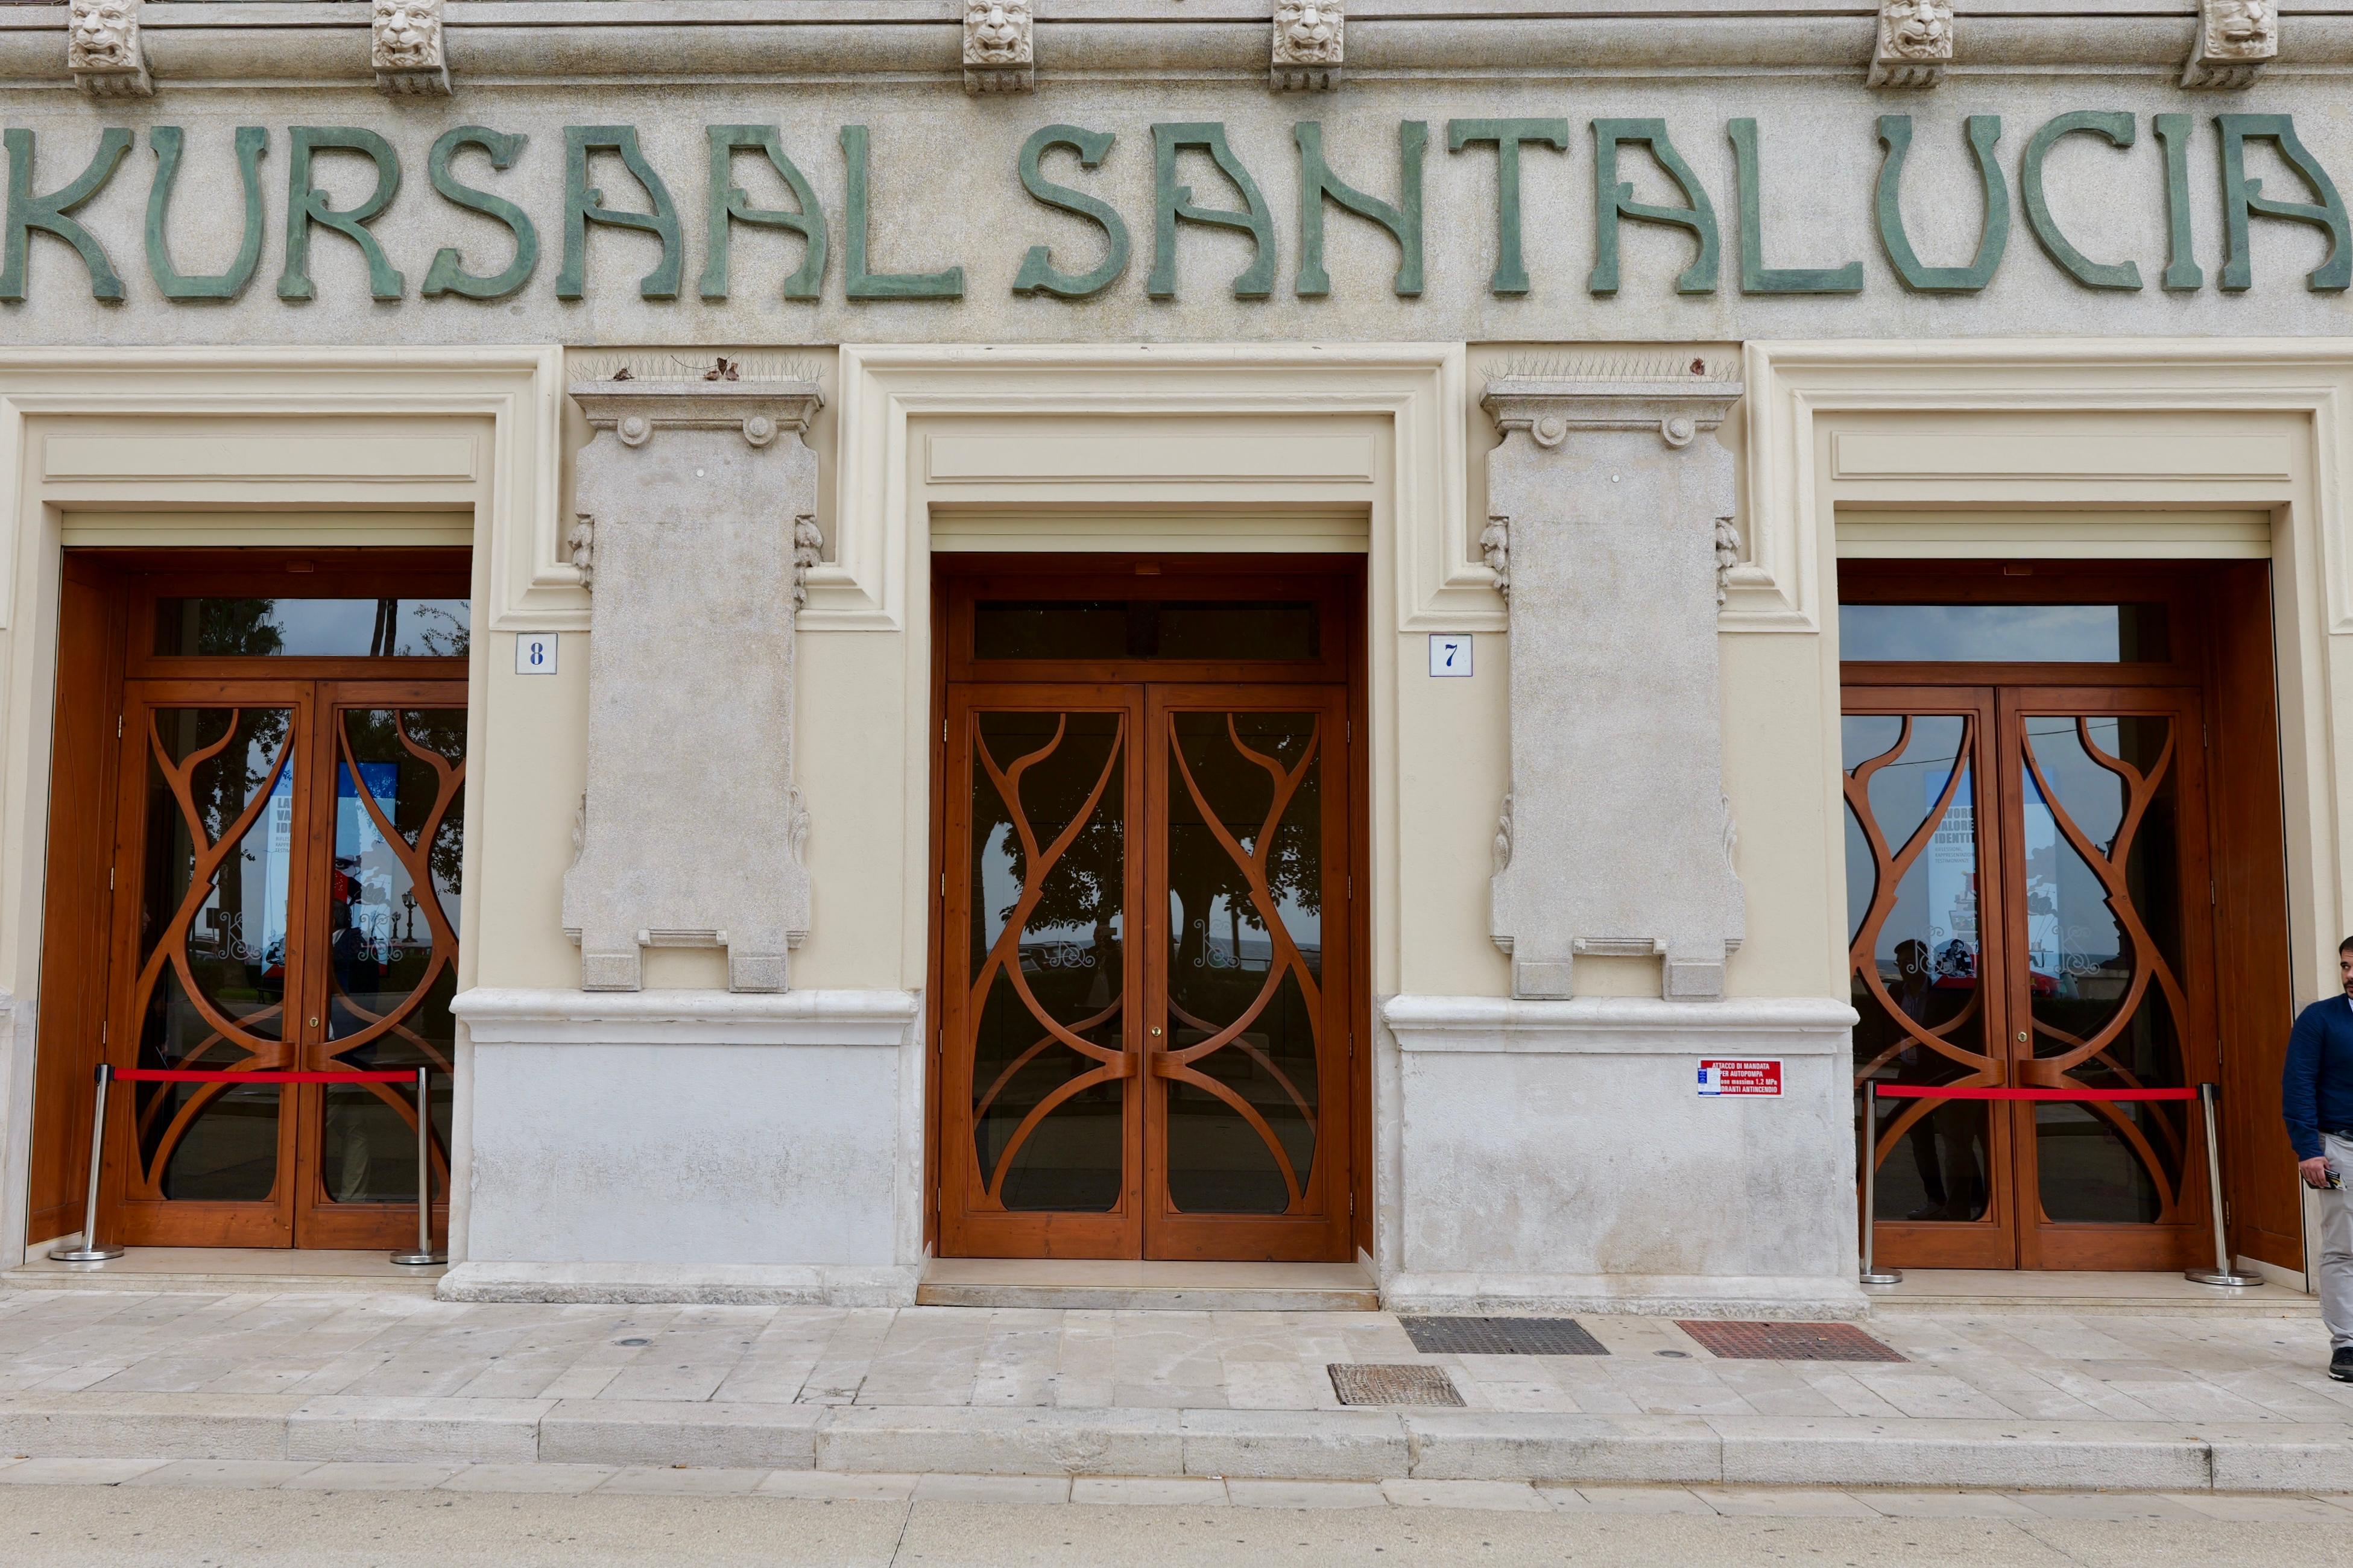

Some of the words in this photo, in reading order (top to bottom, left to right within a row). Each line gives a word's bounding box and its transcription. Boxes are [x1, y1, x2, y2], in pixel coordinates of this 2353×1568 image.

[0, 124, 964, 301] KURSAAL
[1012, 110, 2352, 300] SANTALUCIA
[531, 642, 543, 666] 8
[1445, 644, 1458, 667] 7
